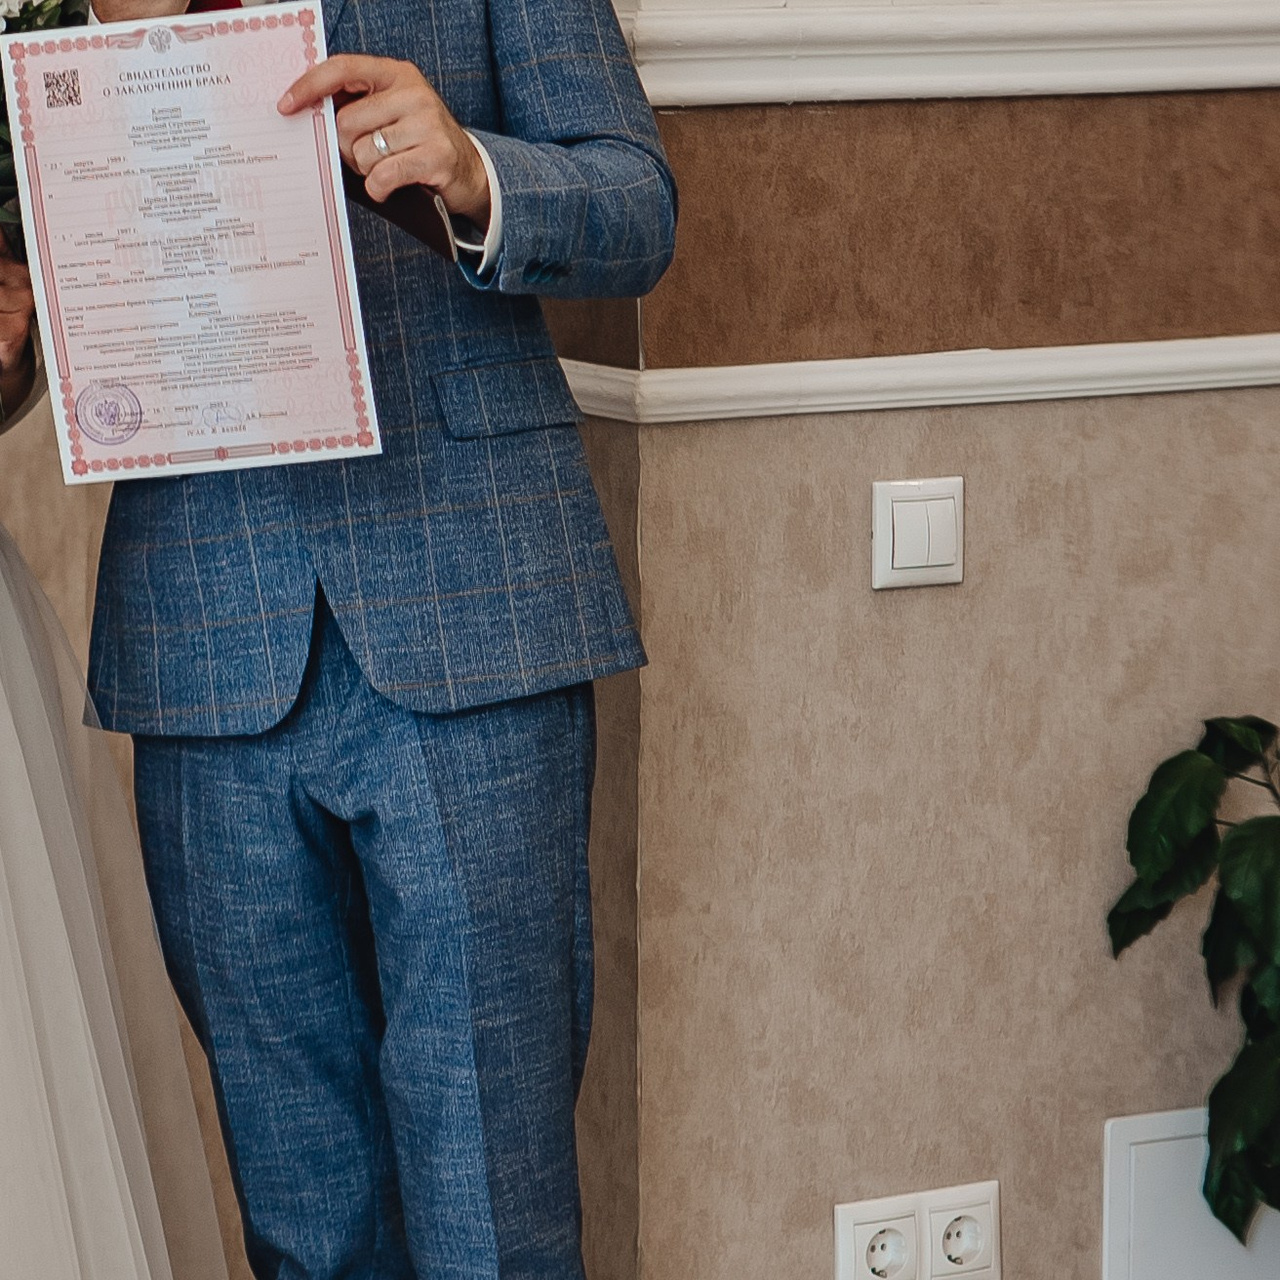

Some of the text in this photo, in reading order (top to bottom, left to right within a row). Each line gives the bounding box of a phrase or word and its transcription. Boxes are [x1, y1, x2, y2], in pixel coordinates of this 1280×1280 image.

[118, 63, 211, 82] СВИДЕТЕЛЬСТВО
[102, 73, 231, 98] О ЗАКЛЮЧЕНИИ БРАКА
